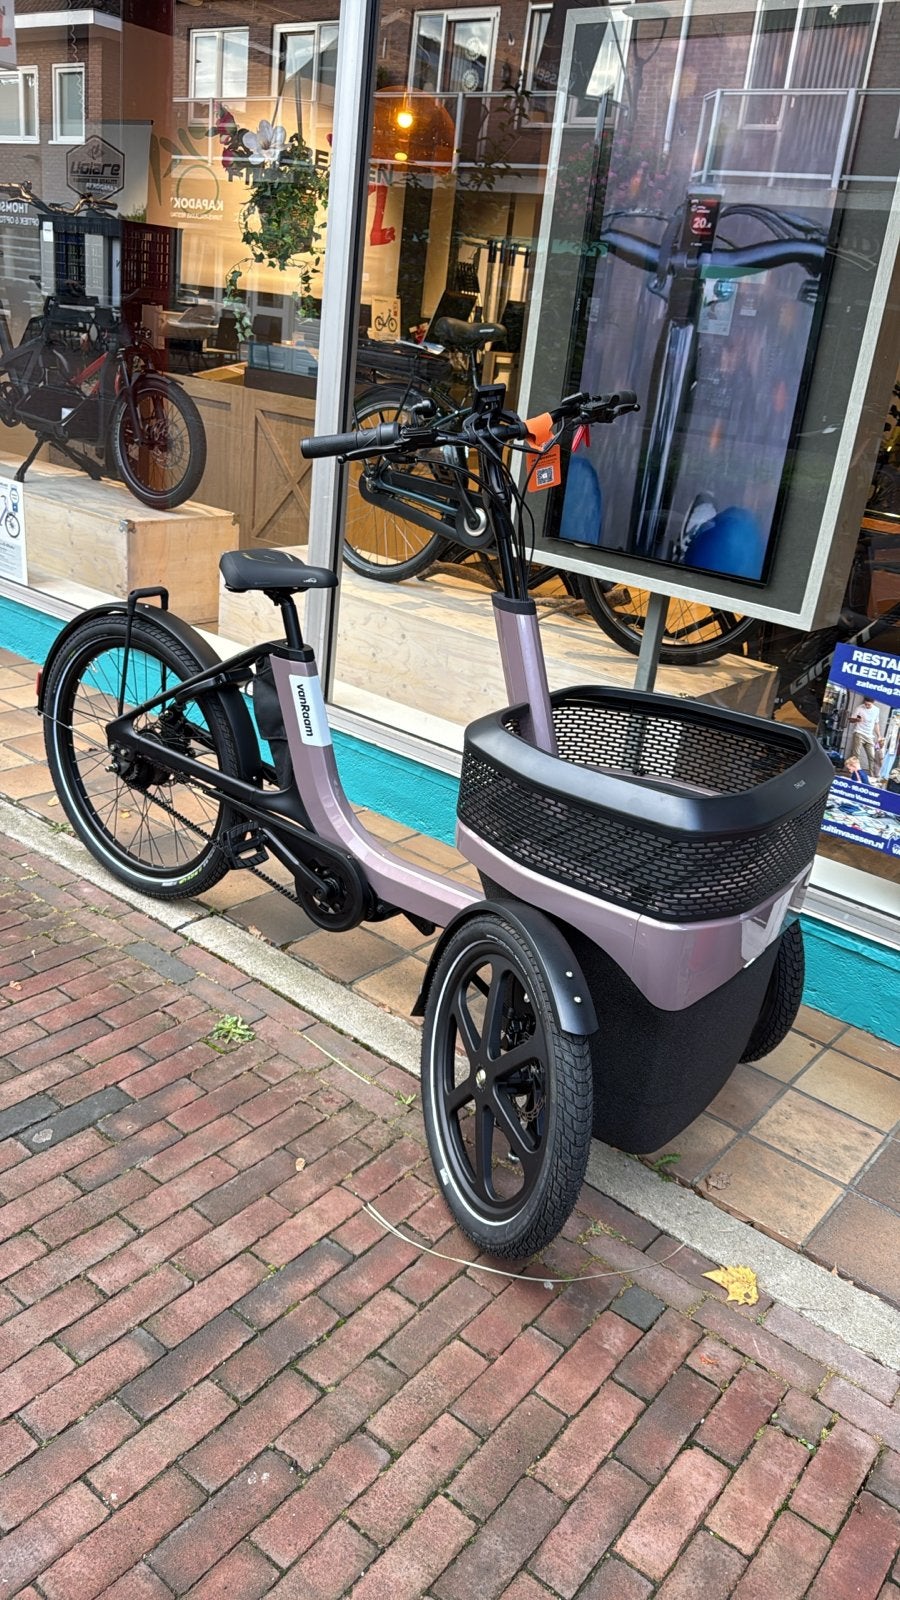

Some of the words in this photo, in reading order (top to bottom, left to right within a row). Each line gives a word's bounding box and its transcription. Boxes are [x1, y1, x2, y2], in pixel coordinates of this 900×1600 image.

[852, 649, 900, 672] RESTA
[855, 680, 893, 696] zaterdag
[296, 683, 314, 737] vanRaam
[855, 794, 880, 806] Vaassen
